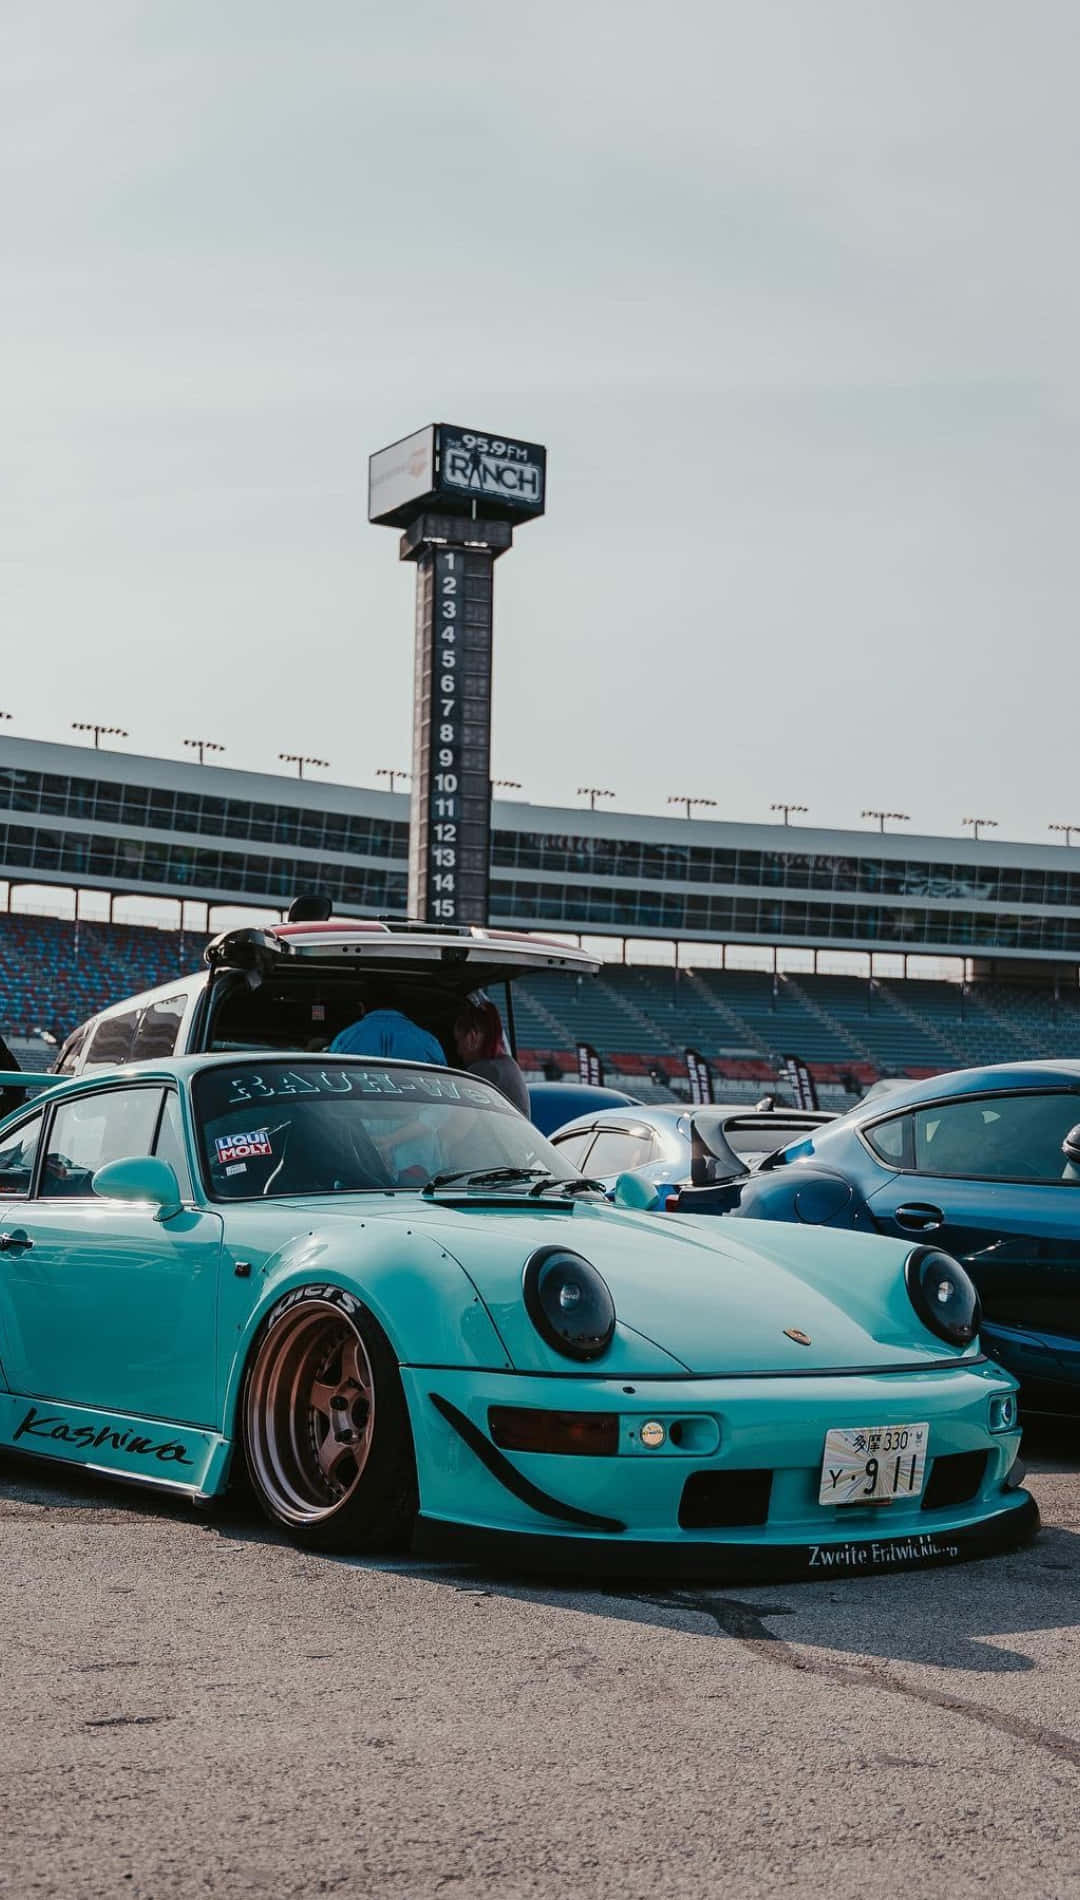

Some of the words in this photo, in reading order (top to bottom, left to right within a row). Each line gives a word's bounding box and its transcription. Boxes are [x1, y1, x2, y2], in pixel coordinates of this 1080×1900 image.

[450, 453, 537, 494] RANCH
[444, 553, 455, 570] 1
[442, 577, 457, 594] 2
[442, 601, 457, 619] 3
[441, 626, 456, 643] 4
[441, 651, 456, 667] 5
[440, 675, 455, 692] 6
[440, 699, 455, 716] 7
[439, 724, 454, 742] 8
[439, 749, 454, 767] 9
[434, 774, 458, 792] 10
[434, 799, 455, 816] 11
[433, 824, 456, 842] 12
[432, 849, 456, 867] 13
[432, 874, 455, 891] 14
[431, 899, 455, 917] 15
[218, 1133, 266, 1149] LIQUI
[221, 1144, 268, 1159] MOLY
[883, 1431, 908, 1451] 330
[863, 1454, 917, 1495] 911
[808, 1544, 867, 1566] Zweite
